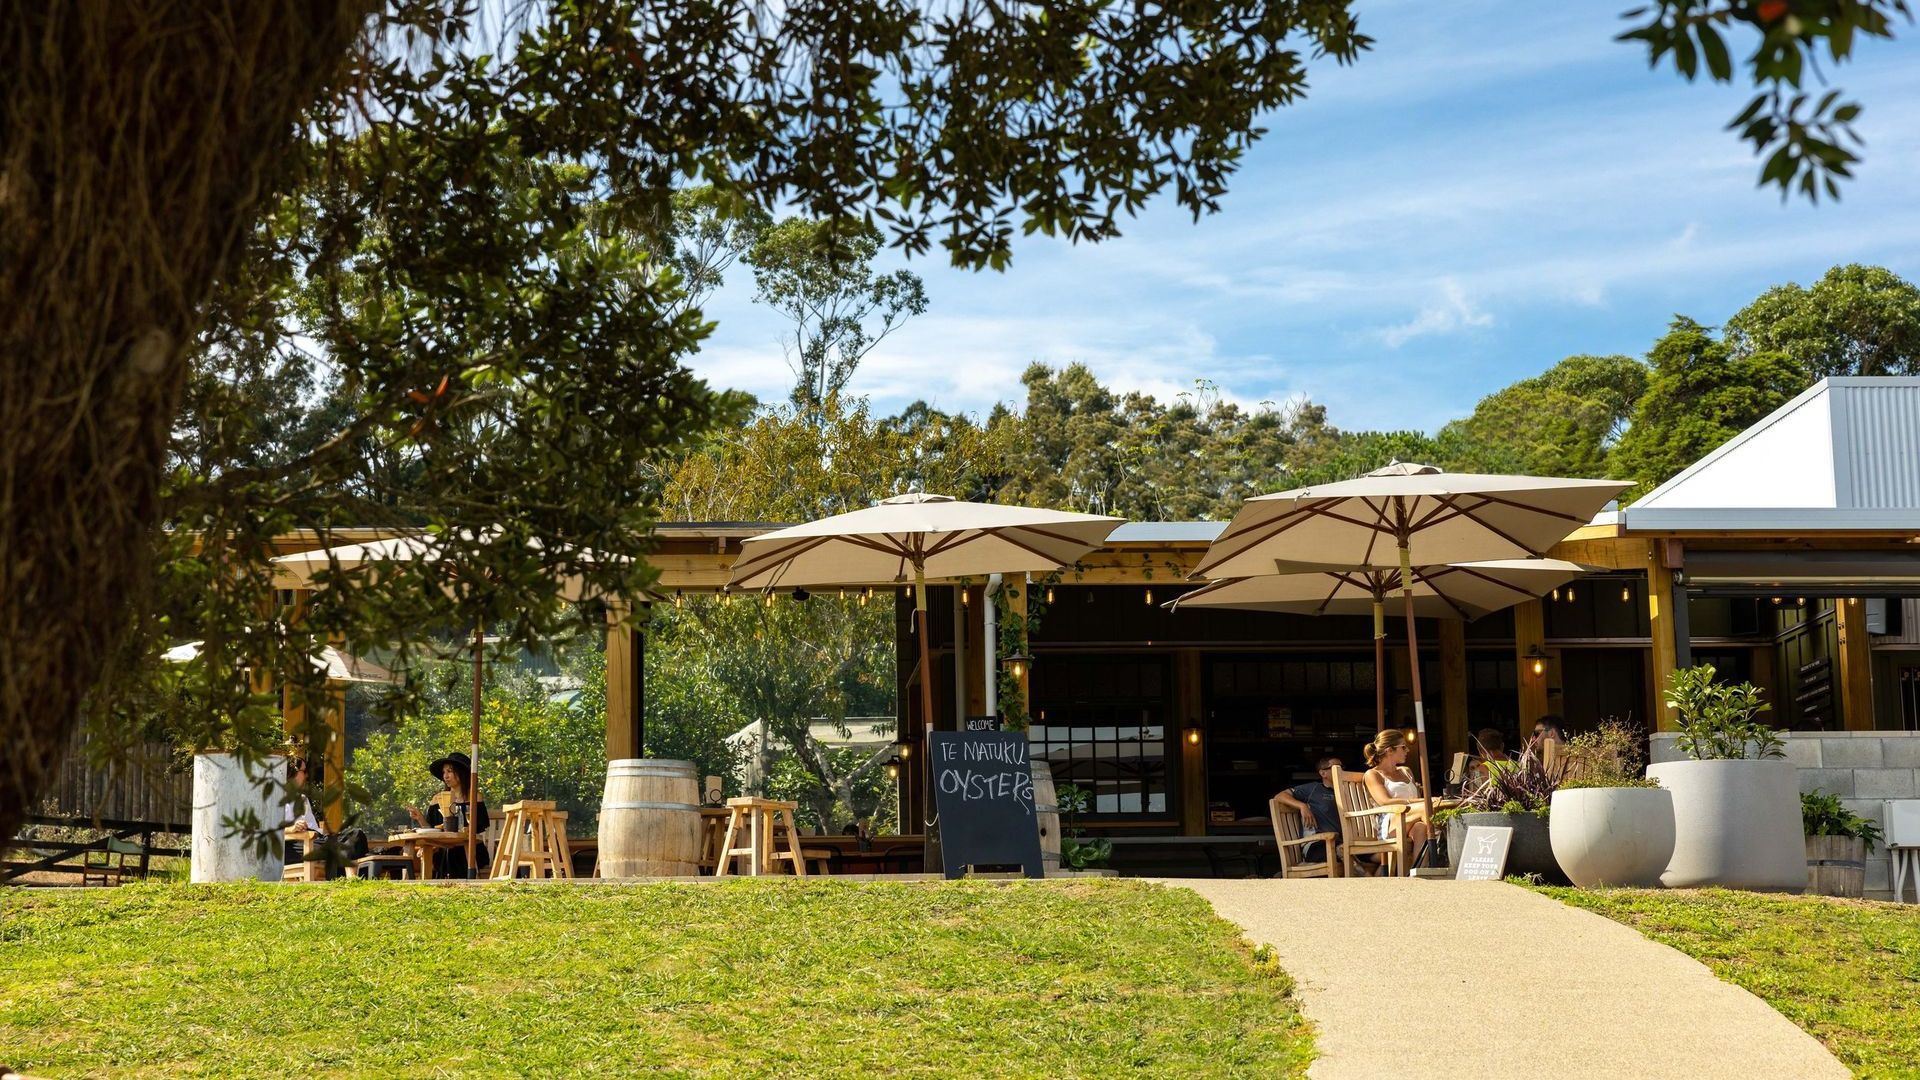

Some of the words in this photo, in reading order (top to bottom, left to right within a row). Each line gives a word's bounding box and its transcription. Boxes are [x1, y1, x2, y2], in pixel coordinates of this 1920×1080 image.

[966, 720, 995, 731] WELCOME
[940, 741, 957, 762] TE
[964, 741, 1026, 765] MATUKU
